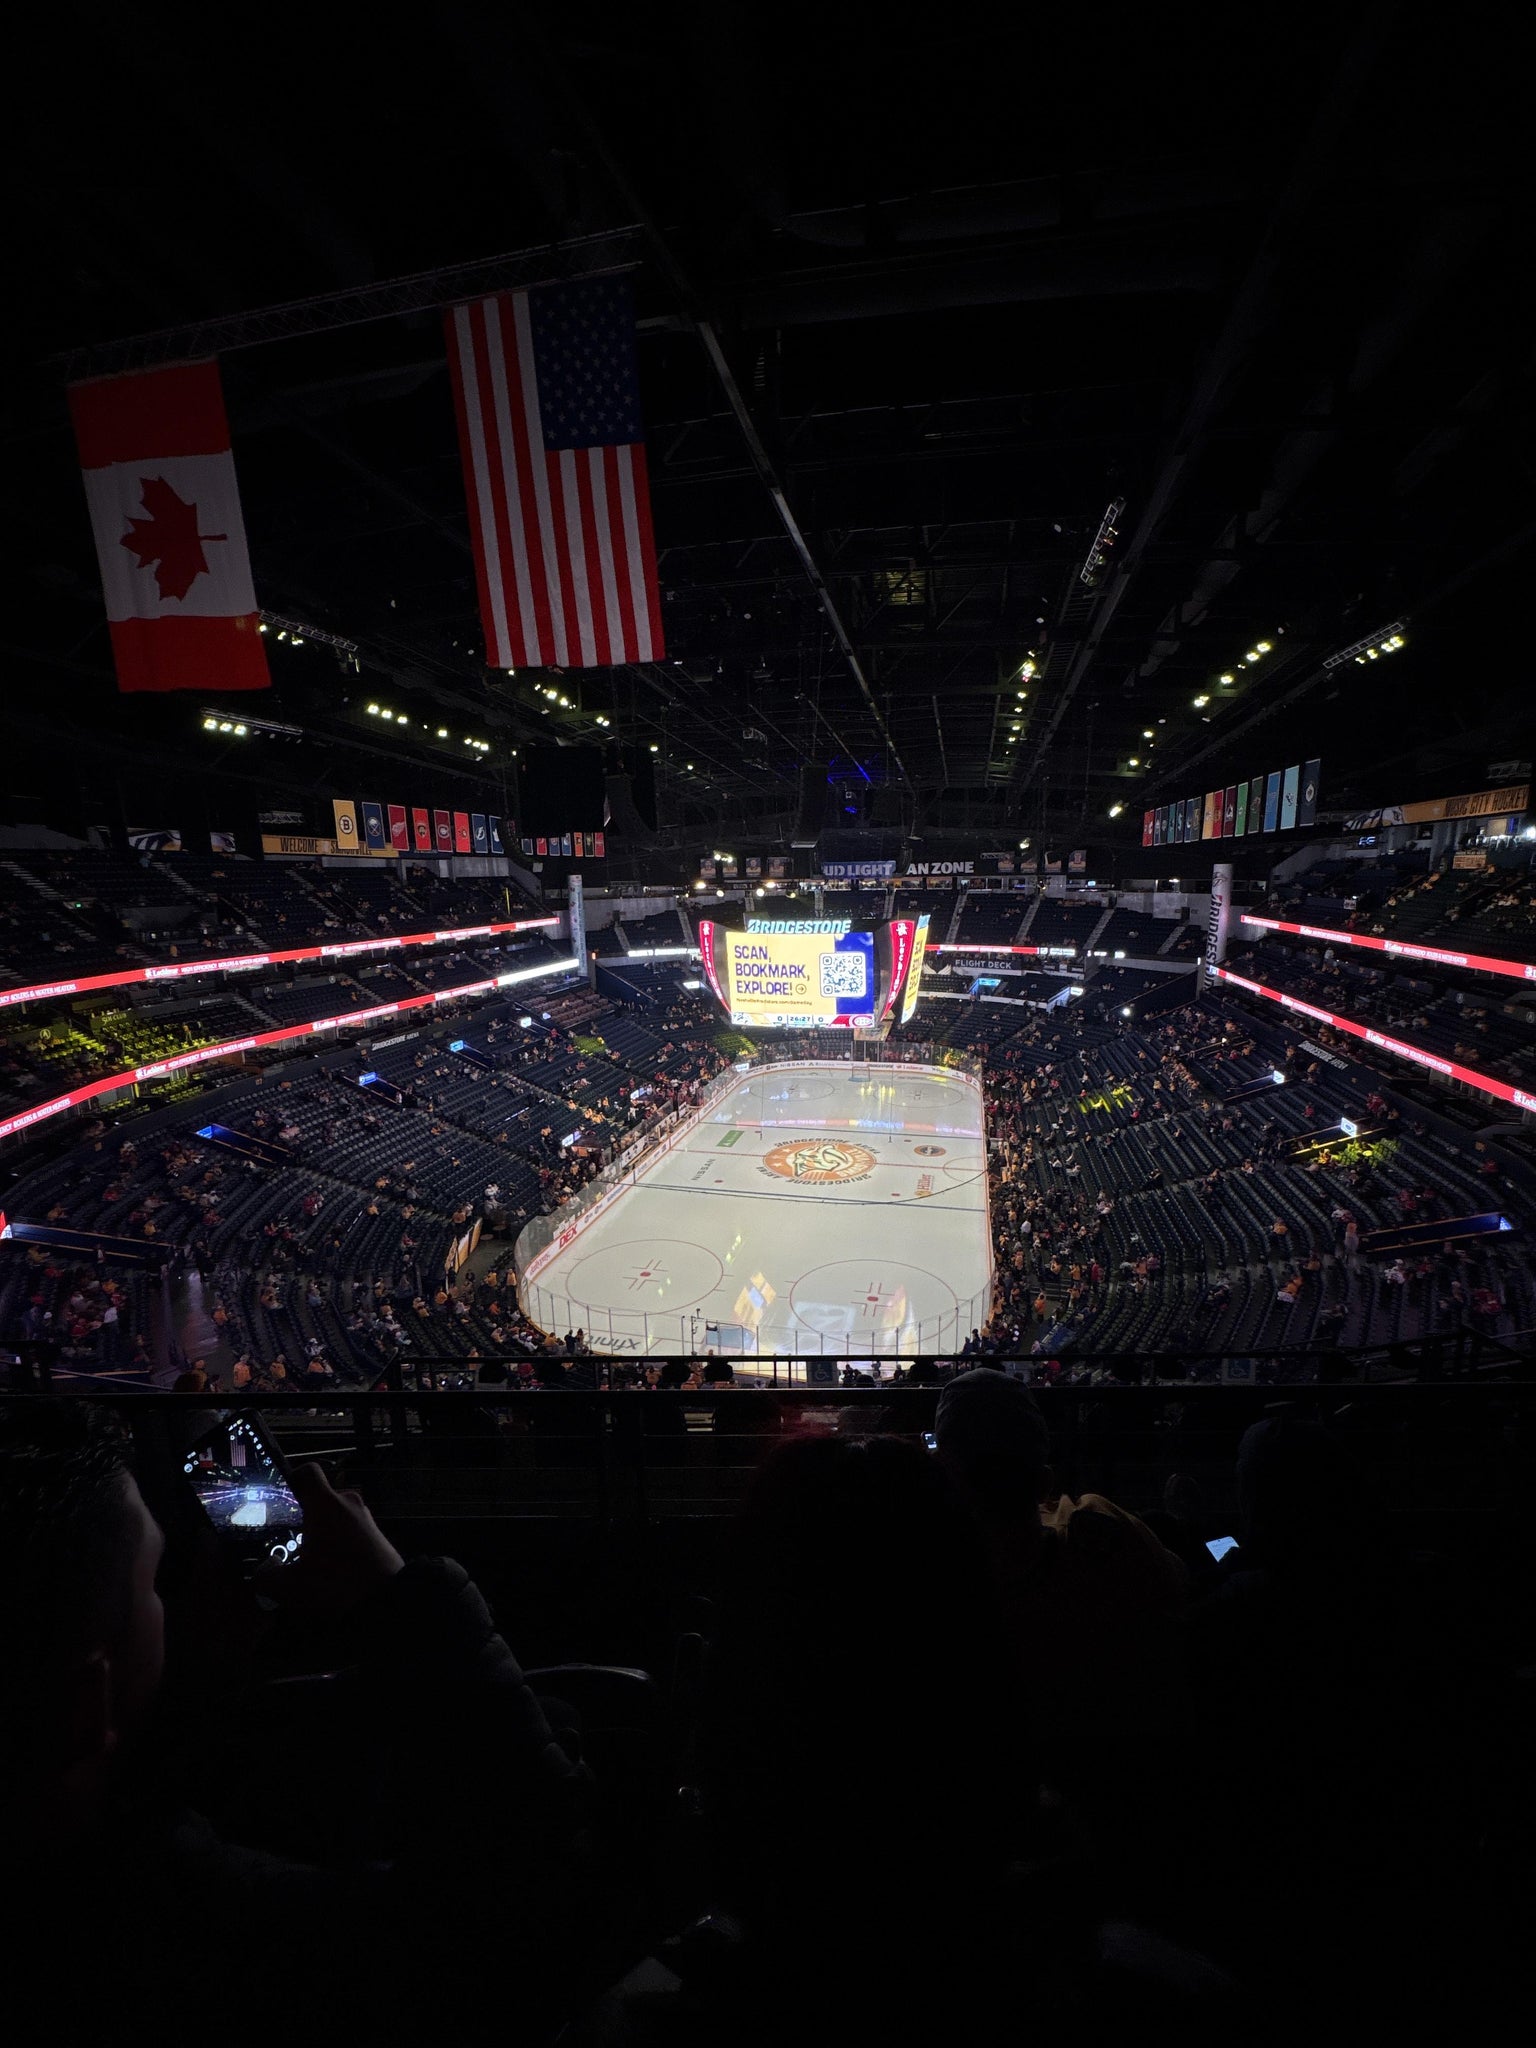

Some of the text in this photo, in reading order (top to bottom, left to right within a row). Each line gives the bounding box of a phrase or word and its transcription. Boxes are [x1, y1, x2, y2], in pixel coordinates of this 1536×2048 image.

[280, 838, 318, 853] WELCOME
[825, 861, 975, 876] UD LIGHT AN ZONE
[747, 919, 852, 934] BRIDGESTONE
[734, 945, 771, 962] SCAN,
[955, 959, 1012, 969] FLIGHT DECK
[735, 963, 810, 981] BOOKMARK,
[736, 981, 793, 996] EXPLORE!
[559, 1224, 578, 1249] DEX
[585, 1335, 640, 1351] xfinit
